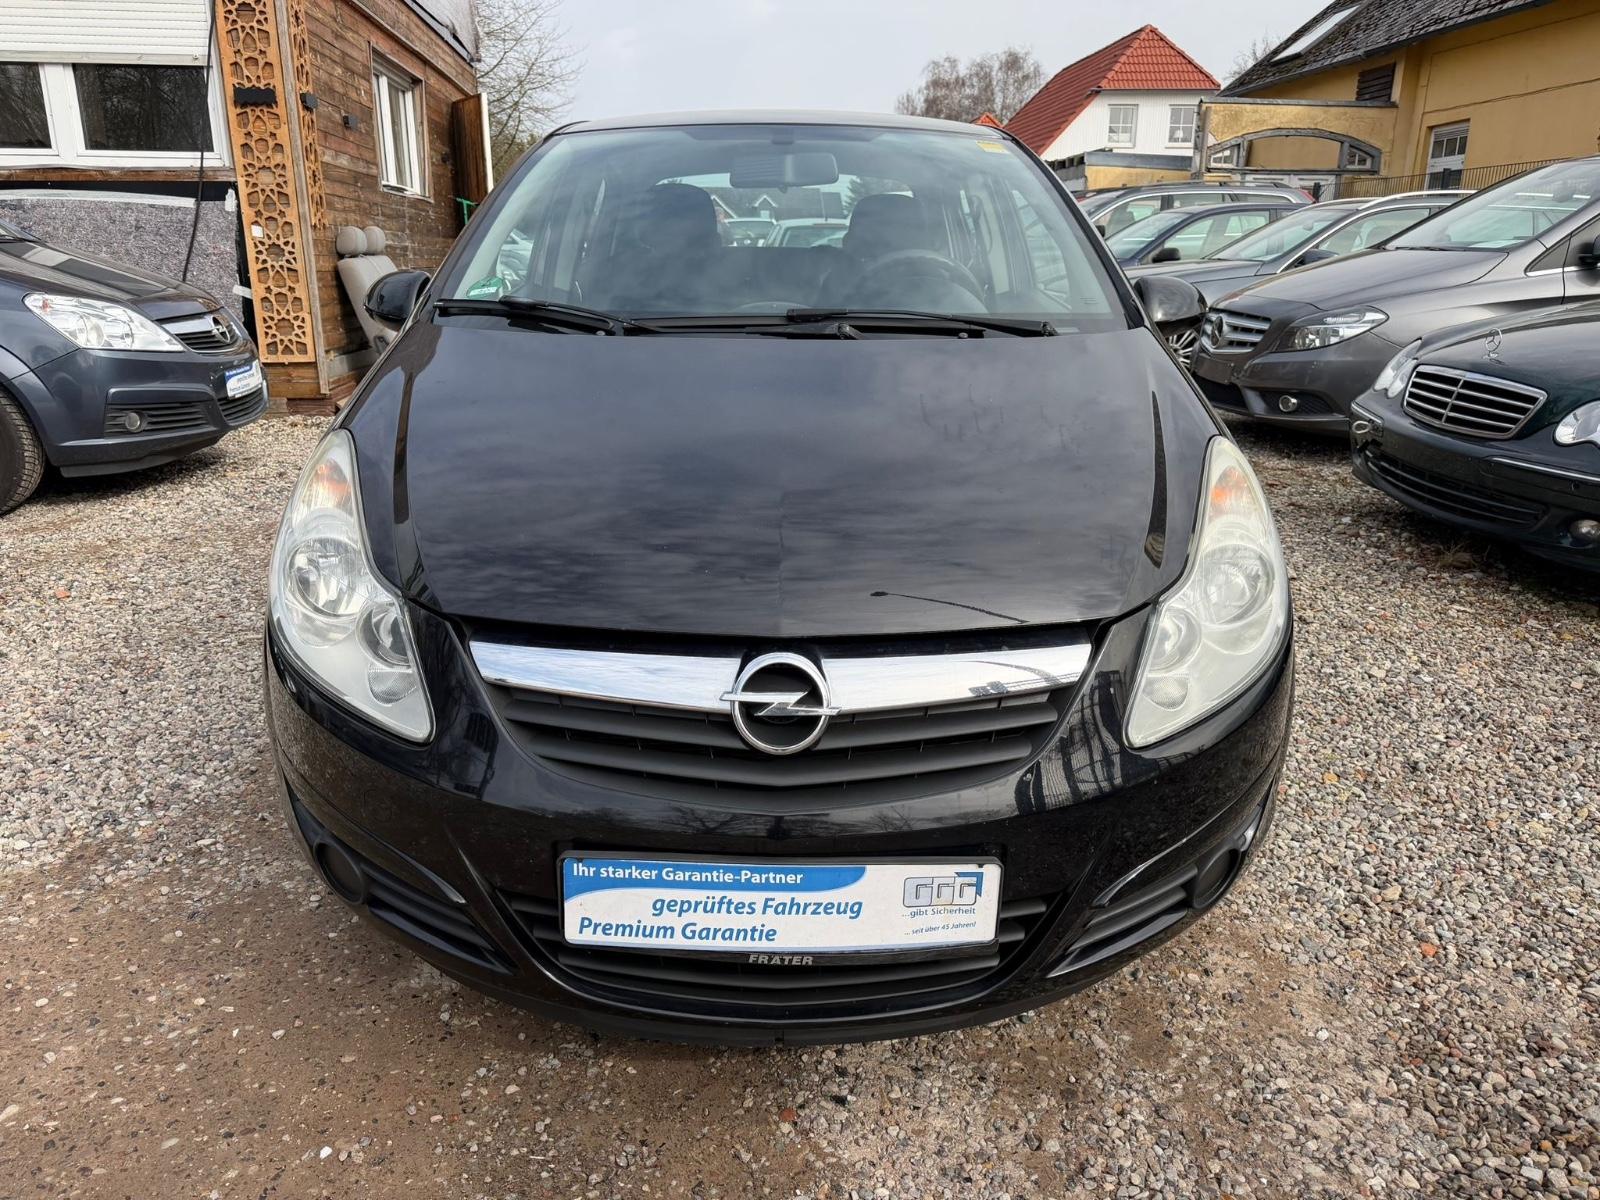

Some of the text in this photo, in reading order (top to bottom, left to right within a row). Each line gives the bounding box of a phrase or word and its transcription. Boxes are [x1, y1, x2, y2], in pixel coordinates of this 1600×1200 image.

[573, 863, 804, 884] Ihr starker Garantie-Partner
[652, 895, 863, 920] geprüftes Fahrzeug
[931, 907, 976, 916] Sicherheit
[578, 917, 777, 942] Premium Garantie
[912, 927, 924, 935] seit
[925, 925, 940, 933] über
[941, 923, 950, 931] 45
